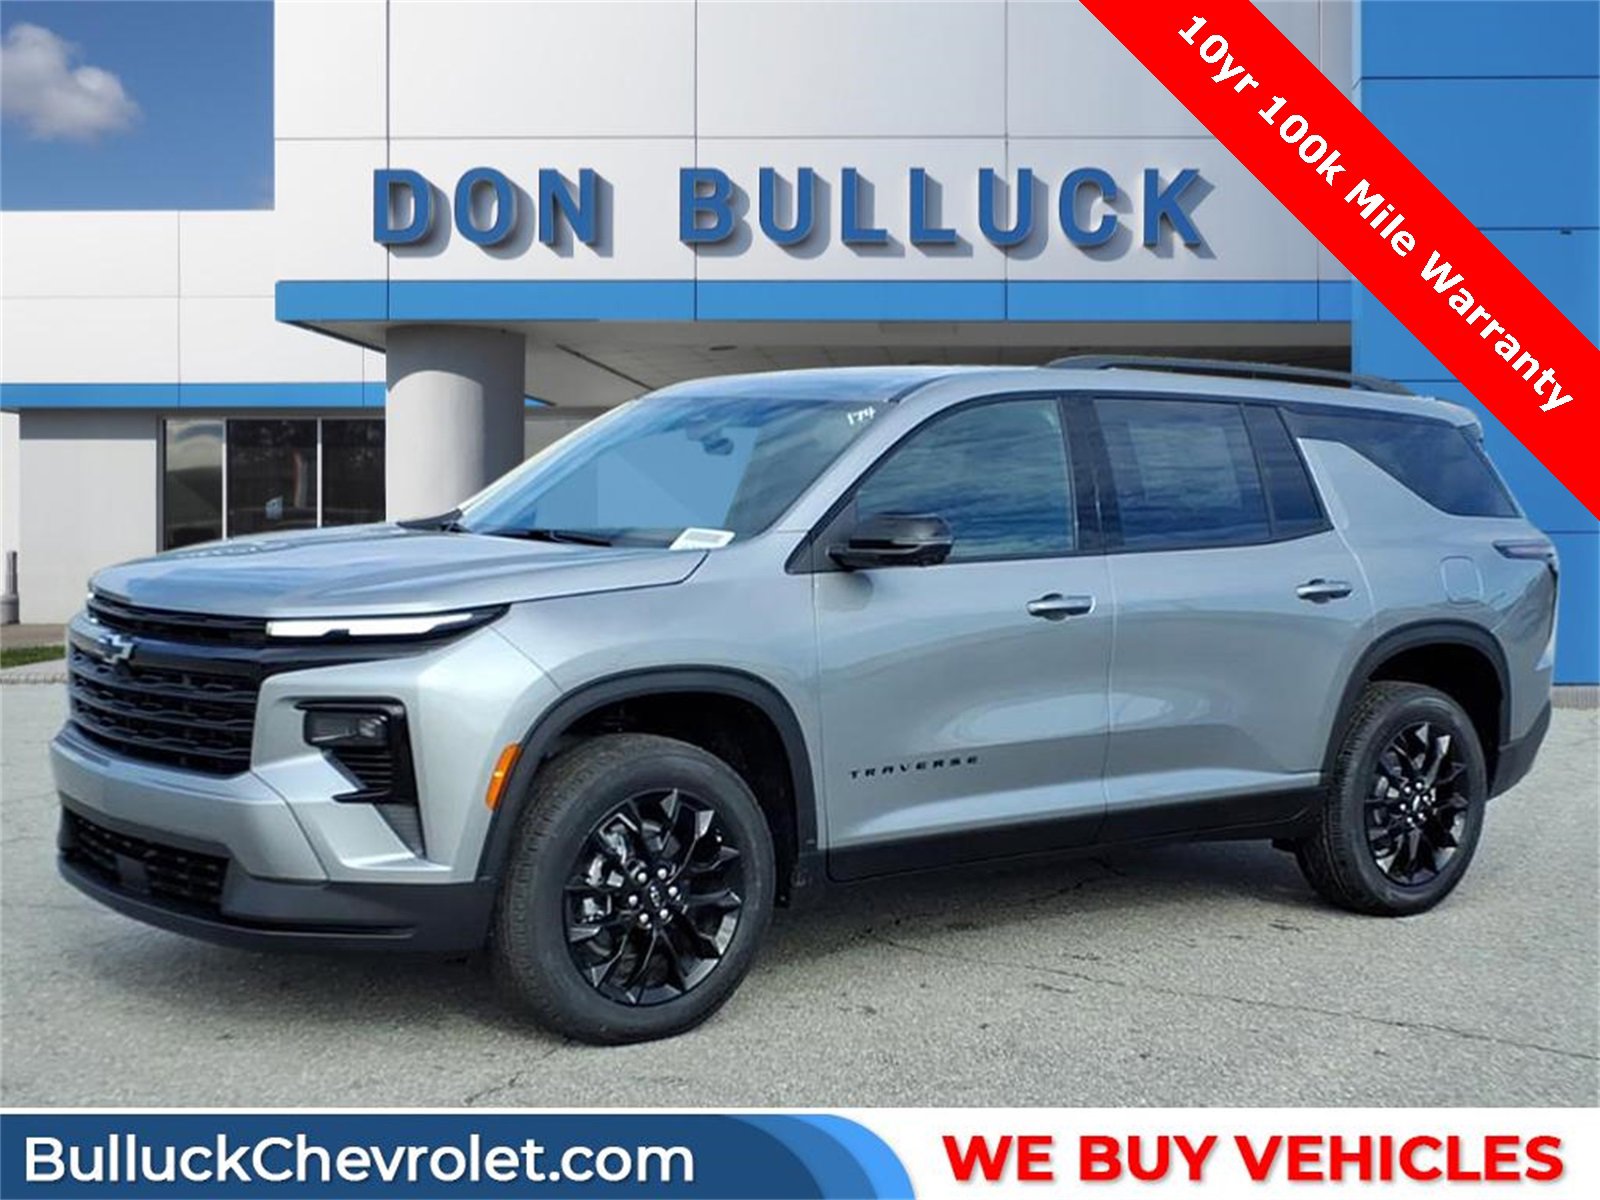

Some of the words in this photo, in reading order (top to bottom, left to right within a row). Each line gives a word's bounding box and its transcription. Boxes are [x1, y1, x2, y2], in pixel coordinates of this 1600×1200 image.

[373, 168, 597, 246] DON
[679, 168, 1204, 246] BULLUCK
[849, 755, 980, 780] TRAVERSE
